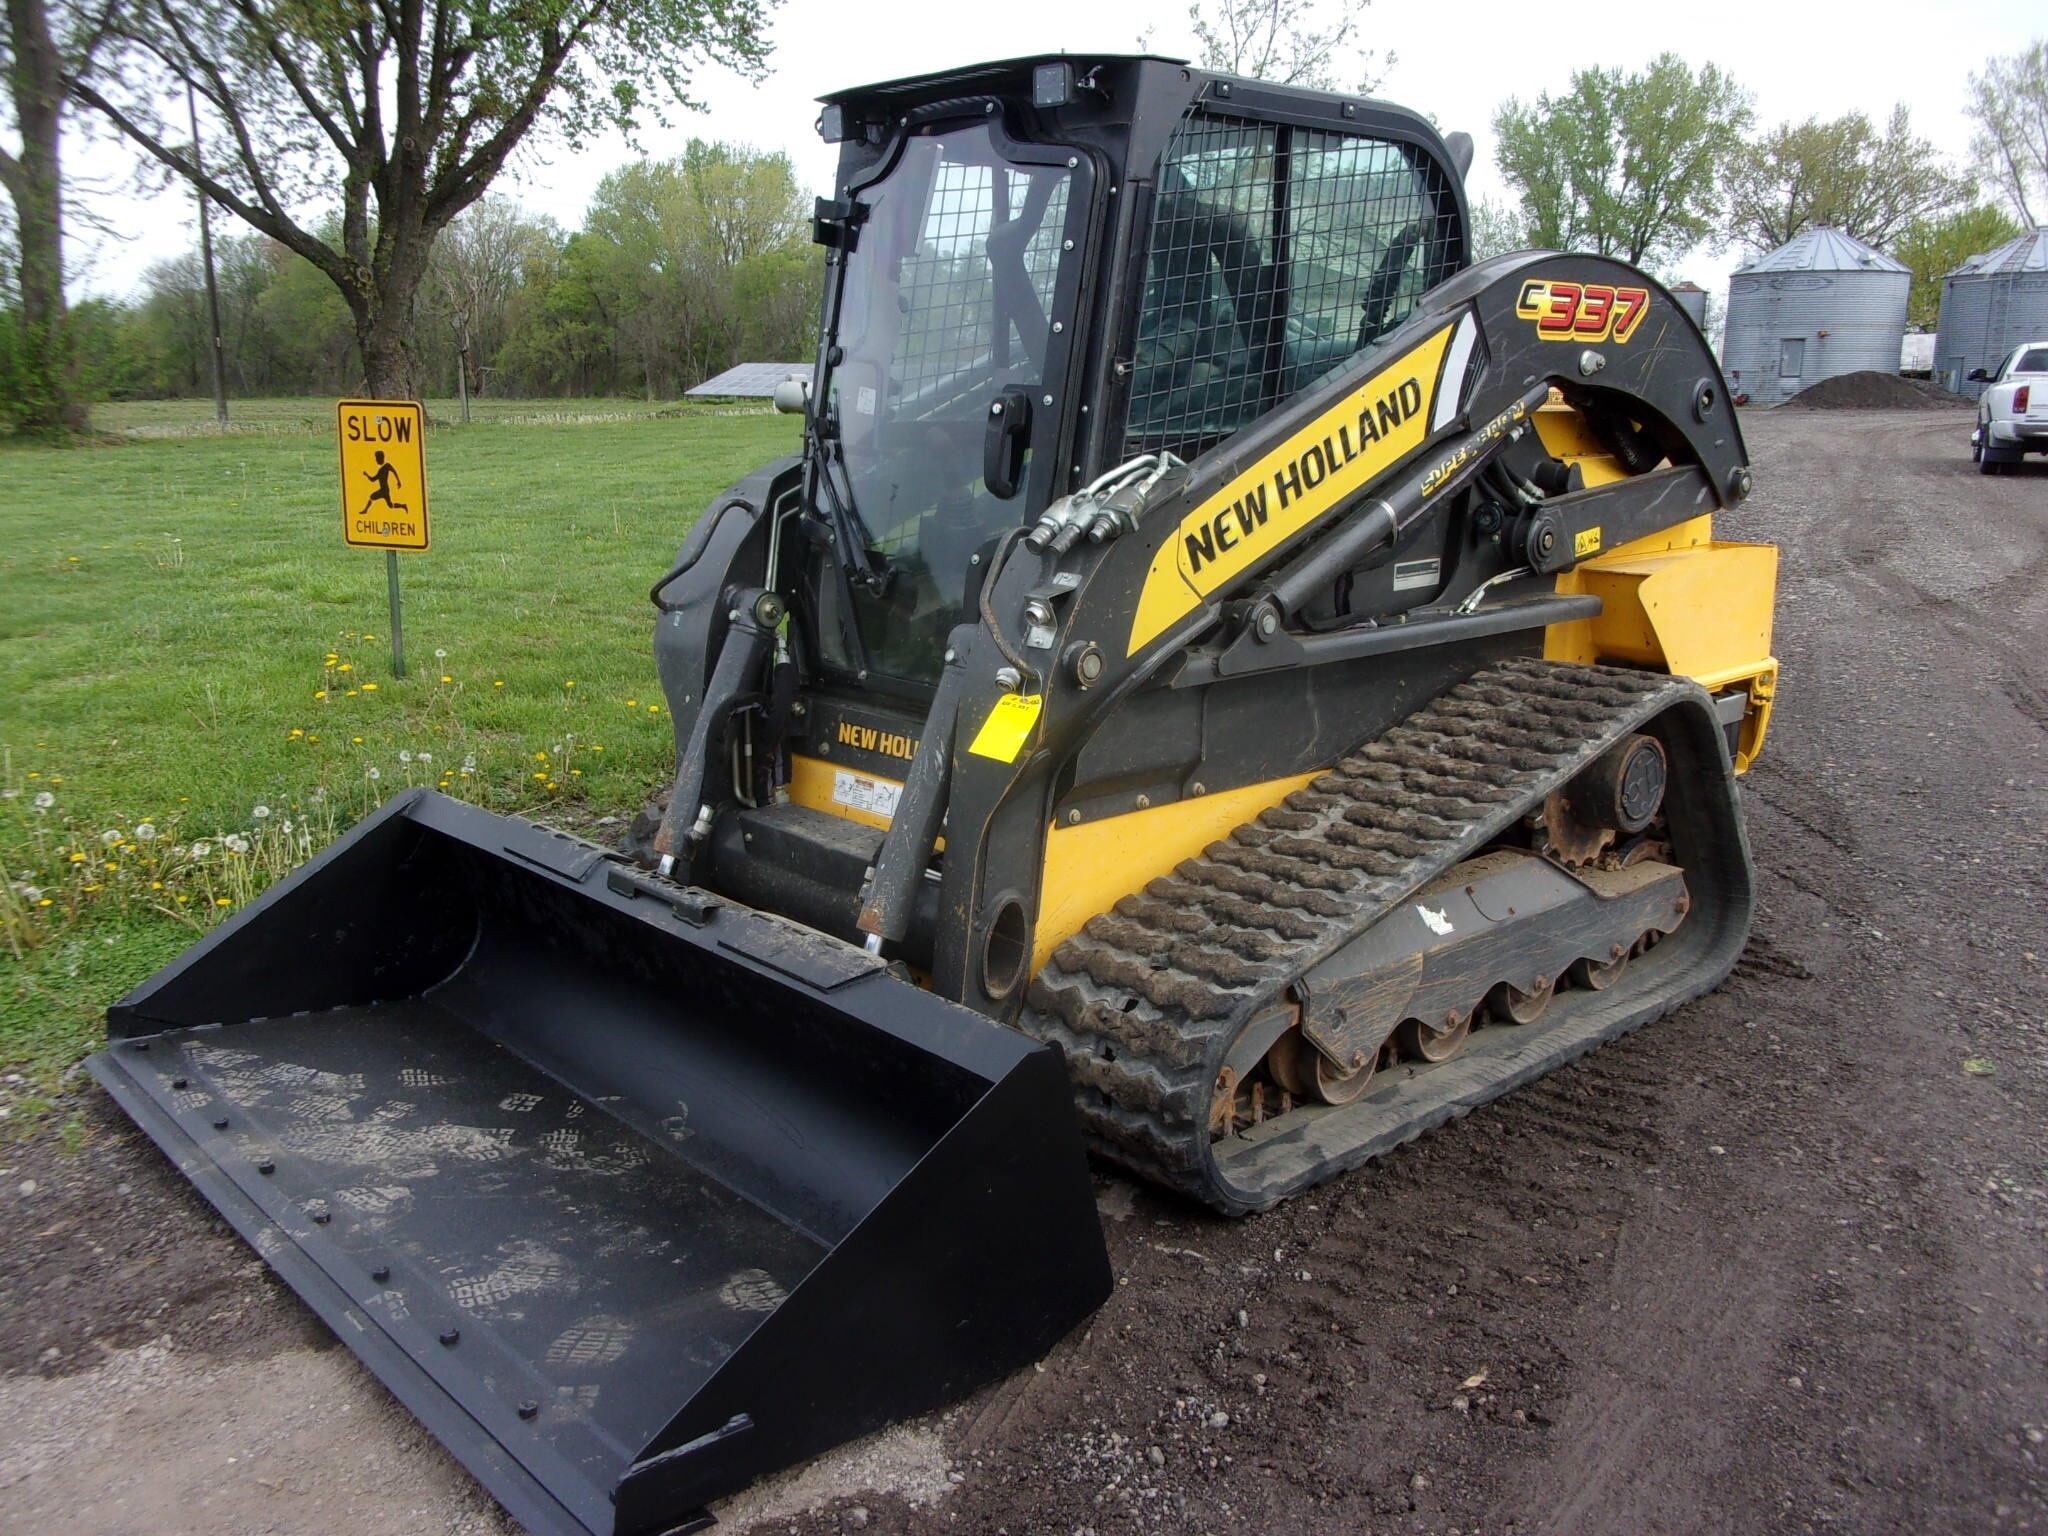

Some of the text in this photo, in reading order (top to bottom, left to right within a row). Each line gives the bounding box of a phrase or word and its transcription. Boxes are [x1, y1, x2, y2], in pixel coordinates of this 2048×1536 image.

[1516, 280, 1649, 343] C337
[347, 415, 412, 443] SLOW
[1184, 377, 1422, 575] NEW HOLLAND
[355, 520, 416, 537] CHILDREN
[838, 722, 878, 751] NEW
